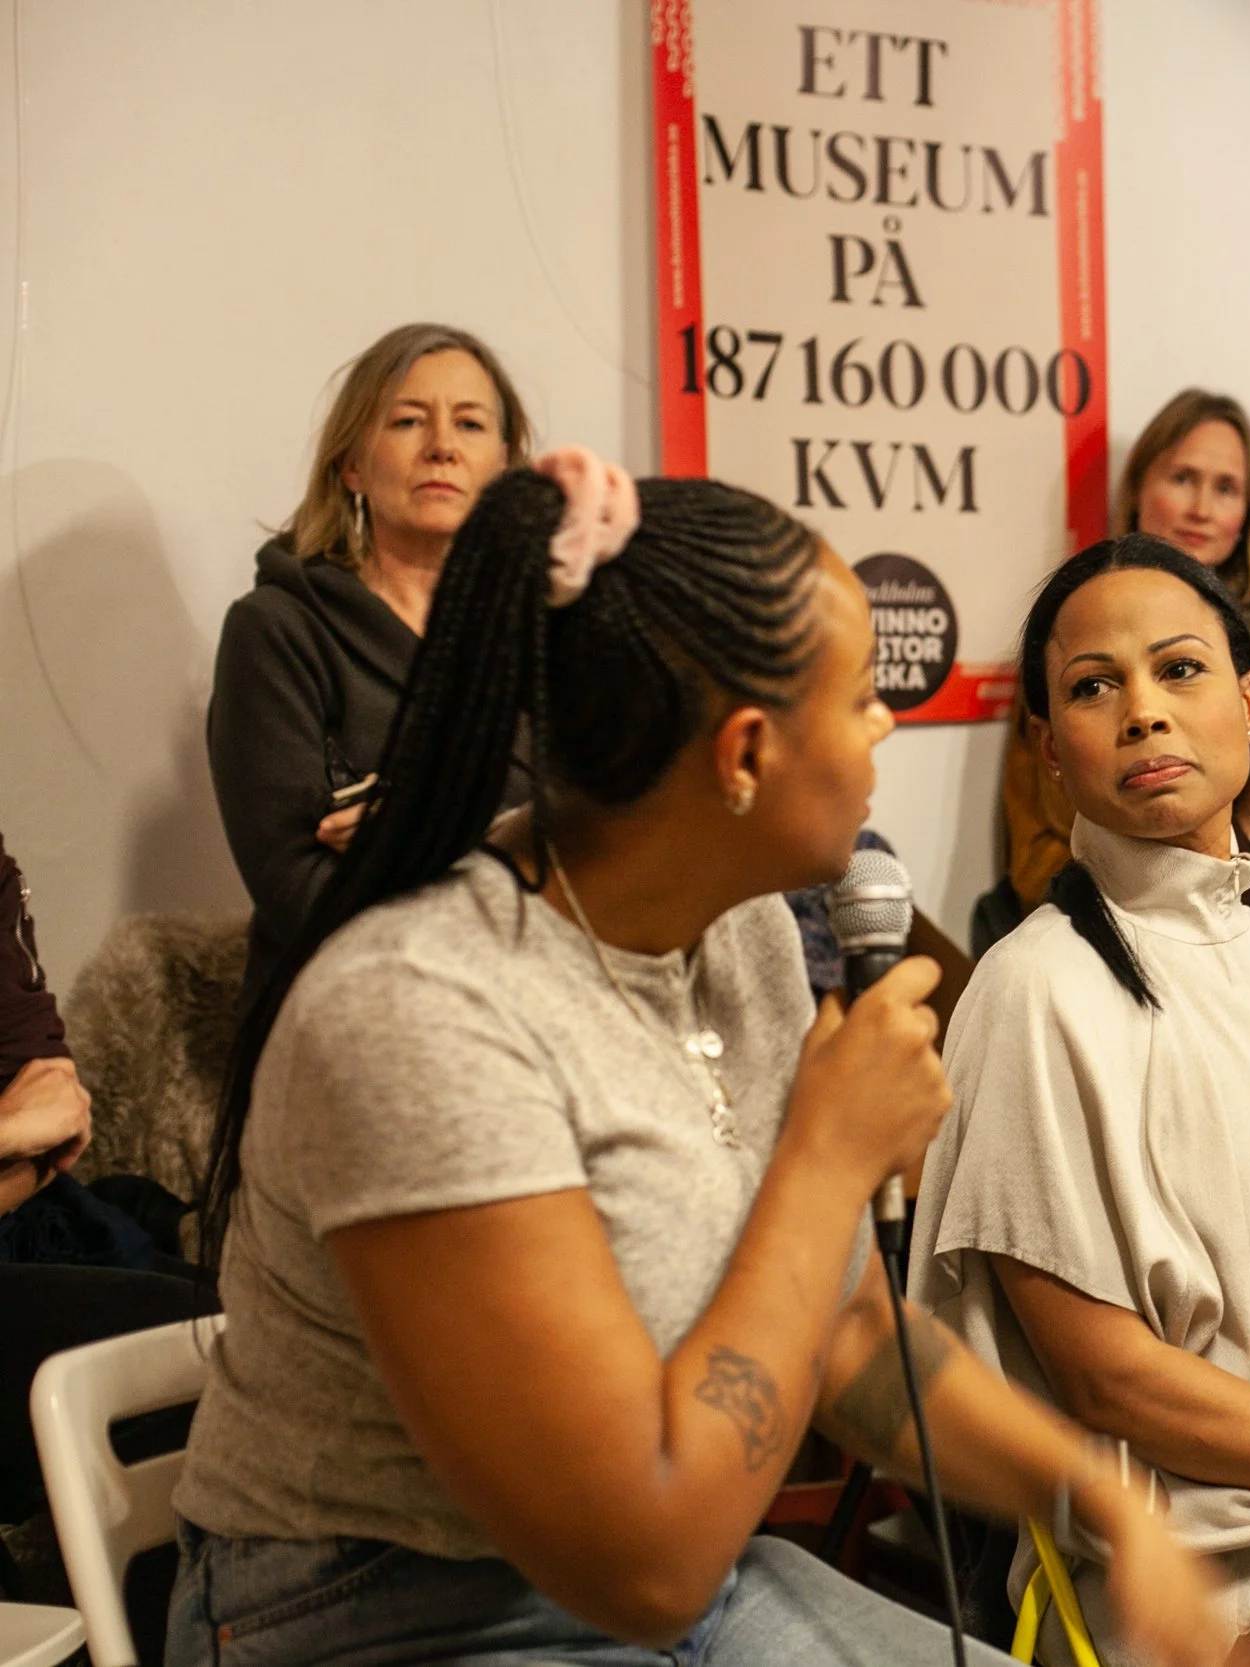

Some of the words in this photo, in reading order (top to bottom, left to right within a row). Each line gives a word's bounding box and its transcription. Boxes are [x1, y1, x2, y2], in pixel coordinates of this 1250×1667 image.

[797, 24, 949, 108] ETT
[702, 113, 1050, 217] MUSEUM
[827, 215, 926, 309] PÅ
[790, 437, 980, 514] KVM
[874, 661, 927, 690] SKA
[876, 634, 943, 663] STOR
